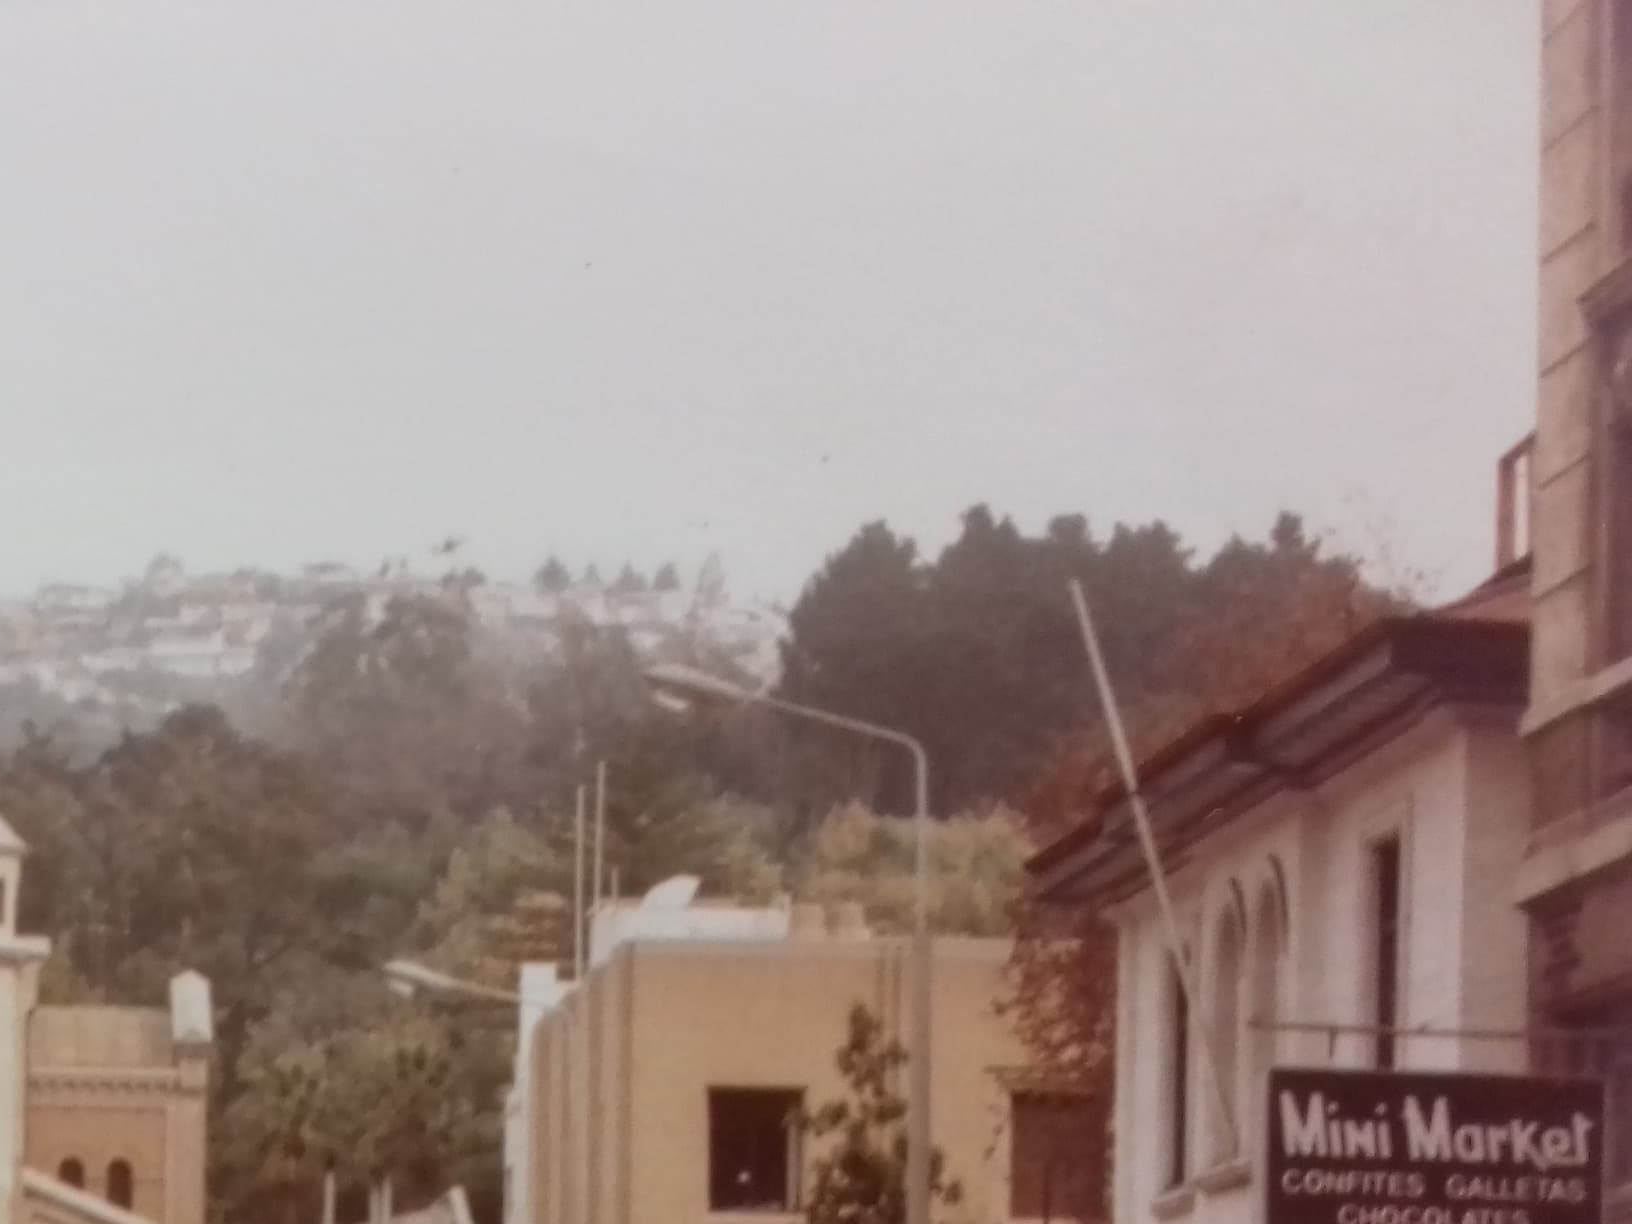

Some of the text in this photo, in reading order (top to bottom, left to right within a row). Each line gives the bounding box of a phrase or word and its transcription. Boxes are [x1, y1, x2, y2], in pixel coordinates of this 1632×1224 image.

[1401, 1094, 1594, 1170] Market
[1280, 1168, 1587, 1204] CONFITES GALLETAS
